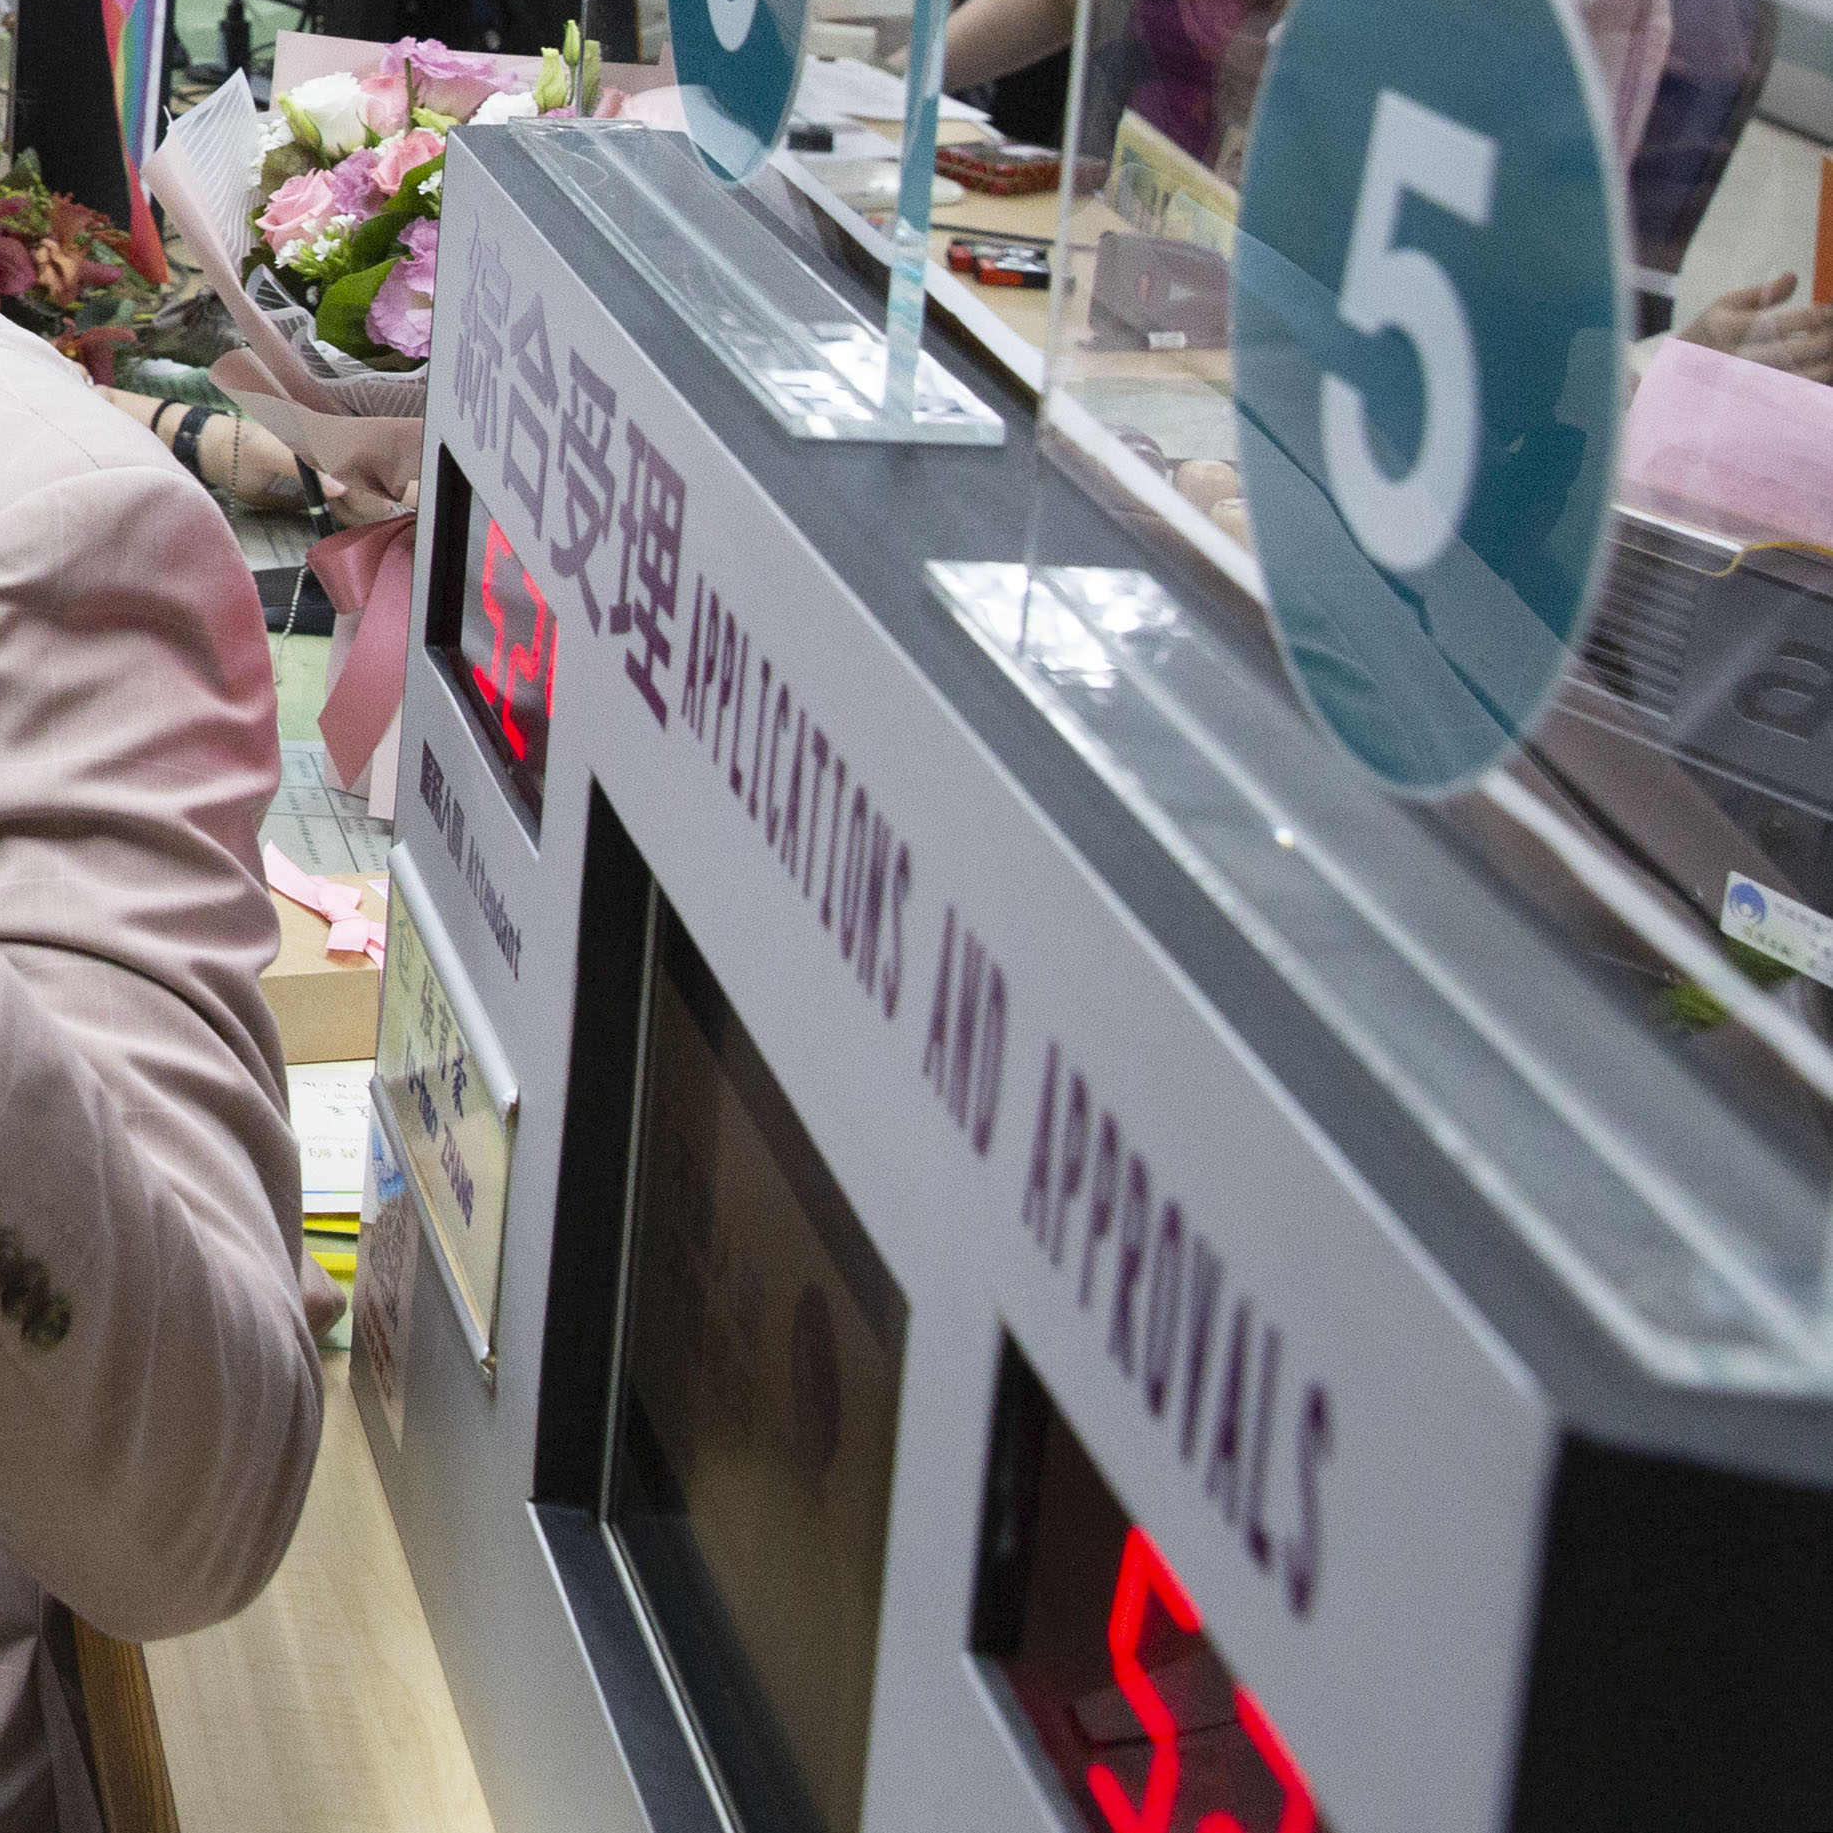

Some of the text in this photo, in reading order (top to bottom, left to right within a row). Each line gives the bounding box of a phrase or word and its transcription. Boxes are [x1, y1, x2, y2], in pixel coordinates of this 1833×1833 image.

[453, 211, 687, 730] 綜合受理
[1319, 89, 1500, 574] 5
[466, 835, 522, 981] Attendant
[681, 572, 1335, 1618] APPLICATIONS AND APPROVALS
